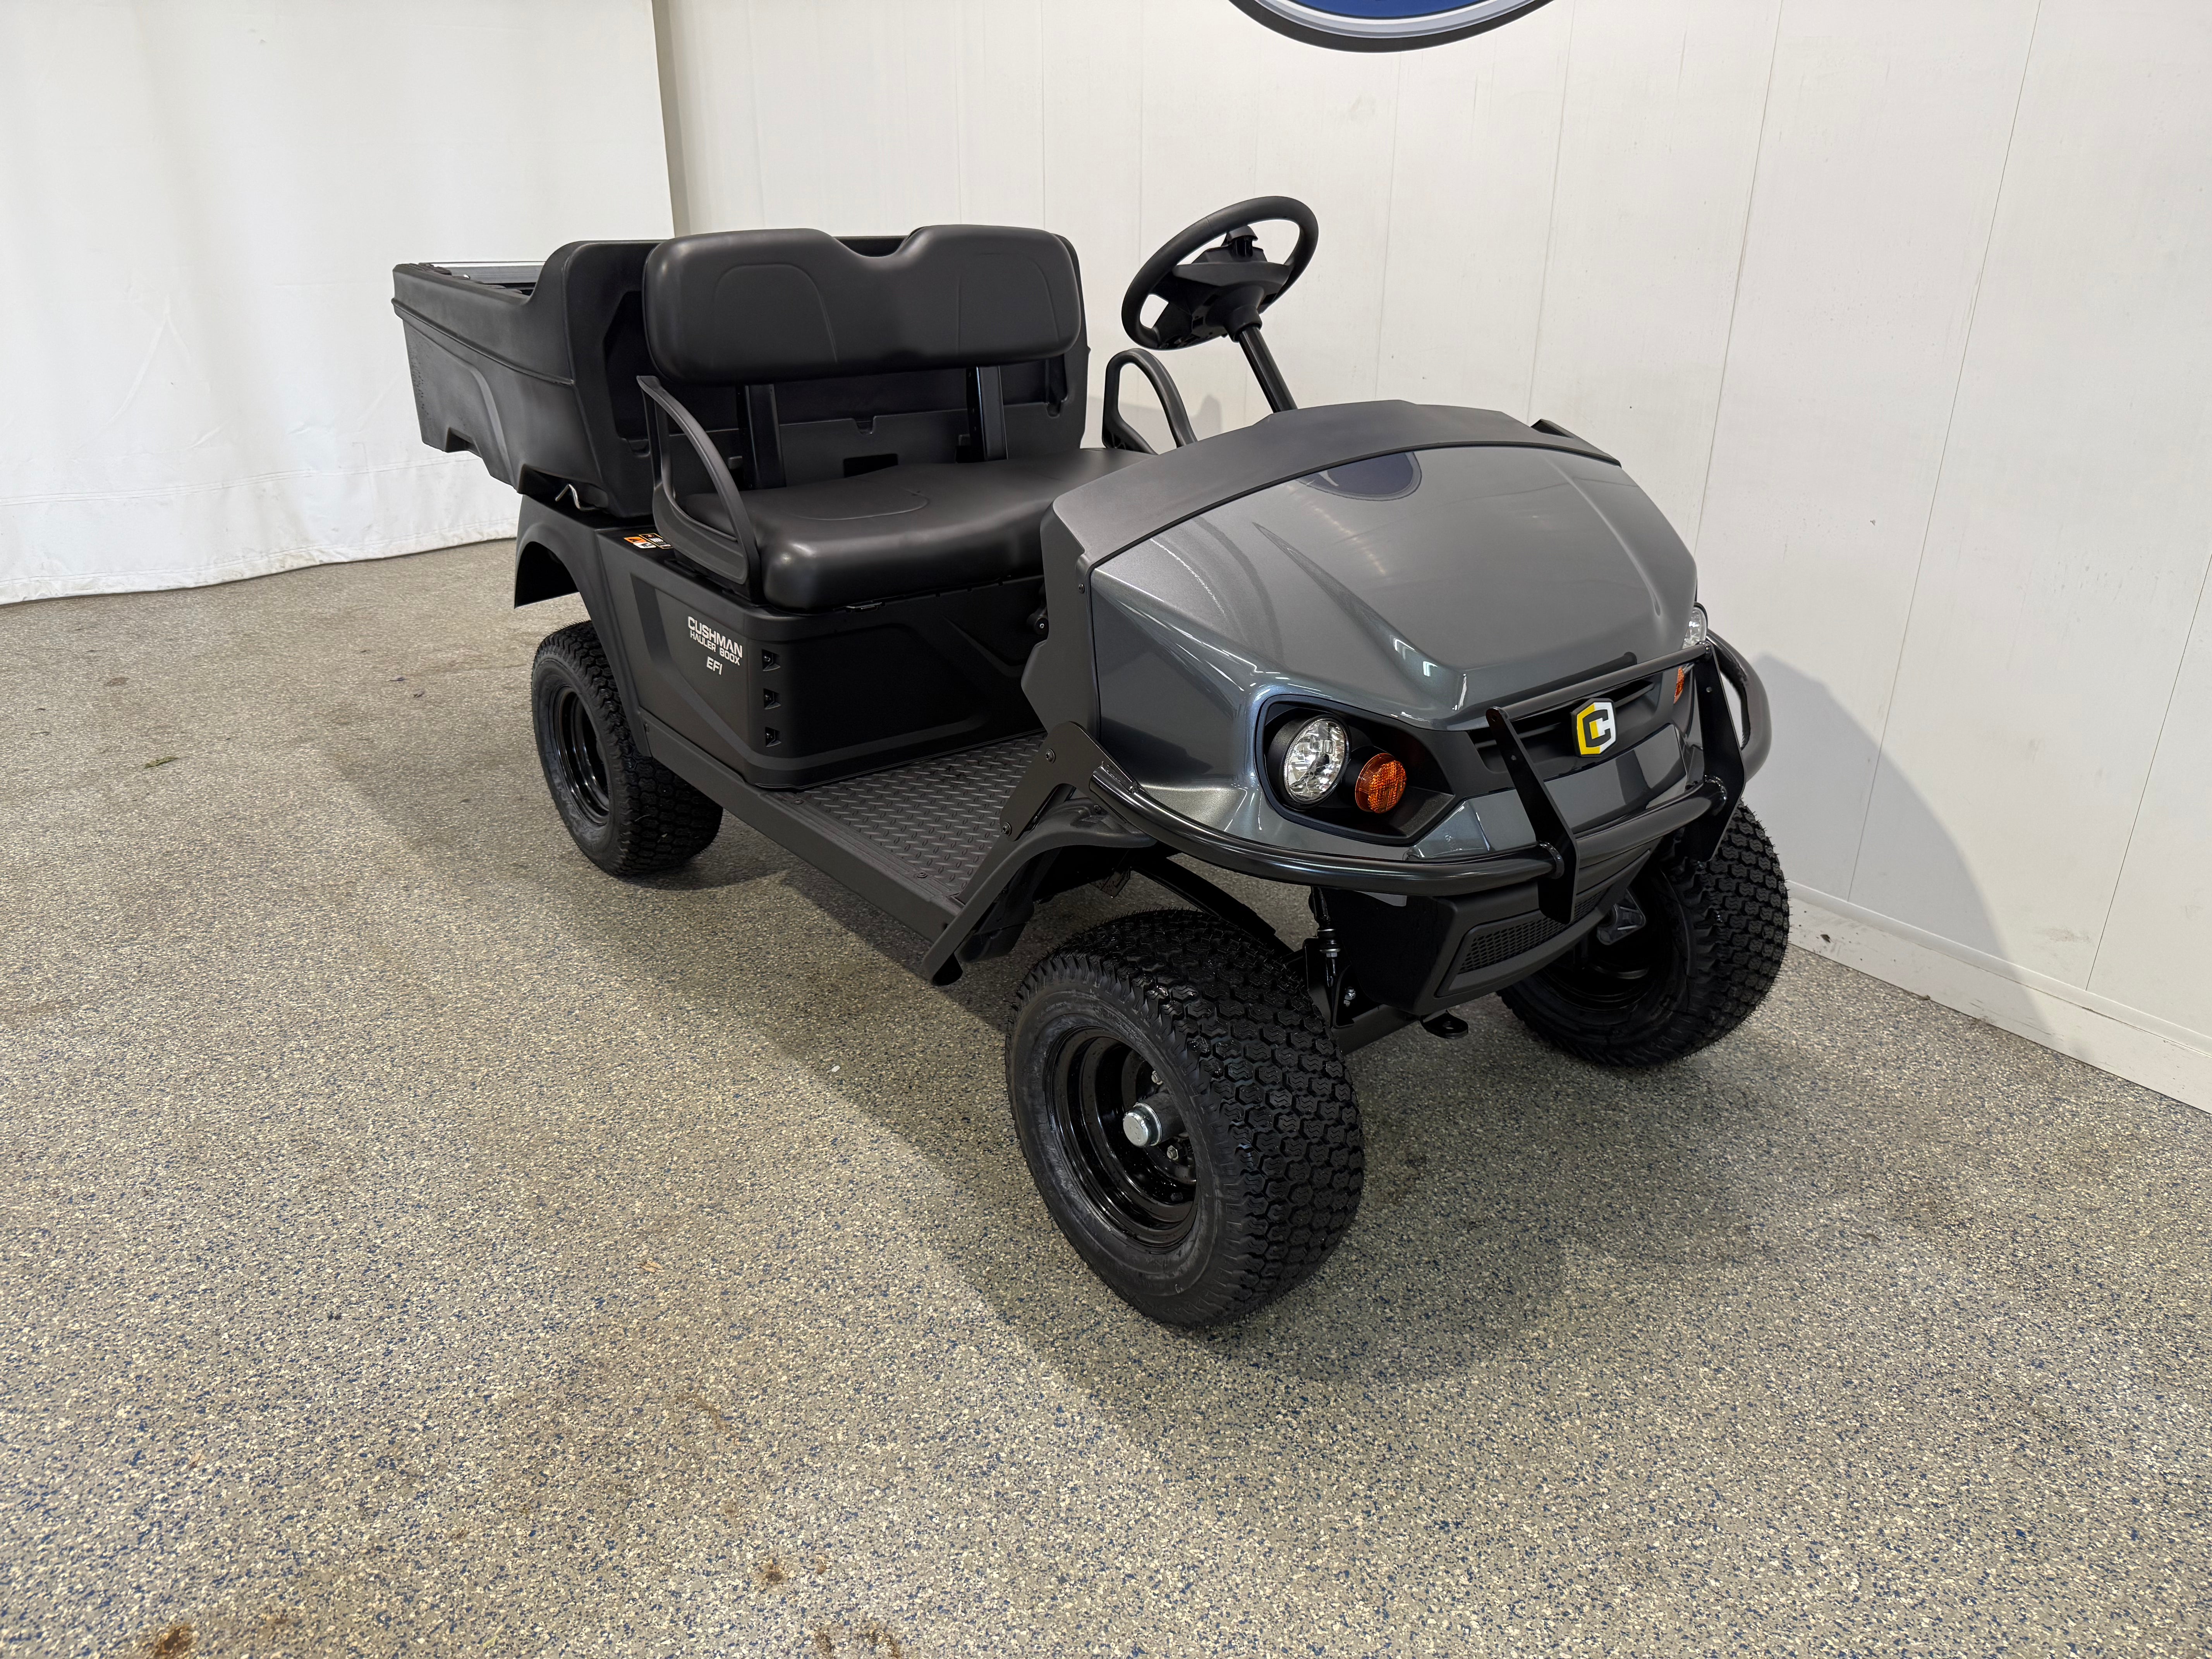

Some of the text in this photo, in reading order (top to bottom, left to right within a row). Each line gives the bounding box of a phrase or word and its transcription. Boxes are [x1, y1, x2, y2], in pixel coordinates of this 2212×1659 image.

[688, 616, 742, 658] CUSHMAN
[690, 630, 740, 666] HAULER 800X
[707, 656, 723, 675] EFI
